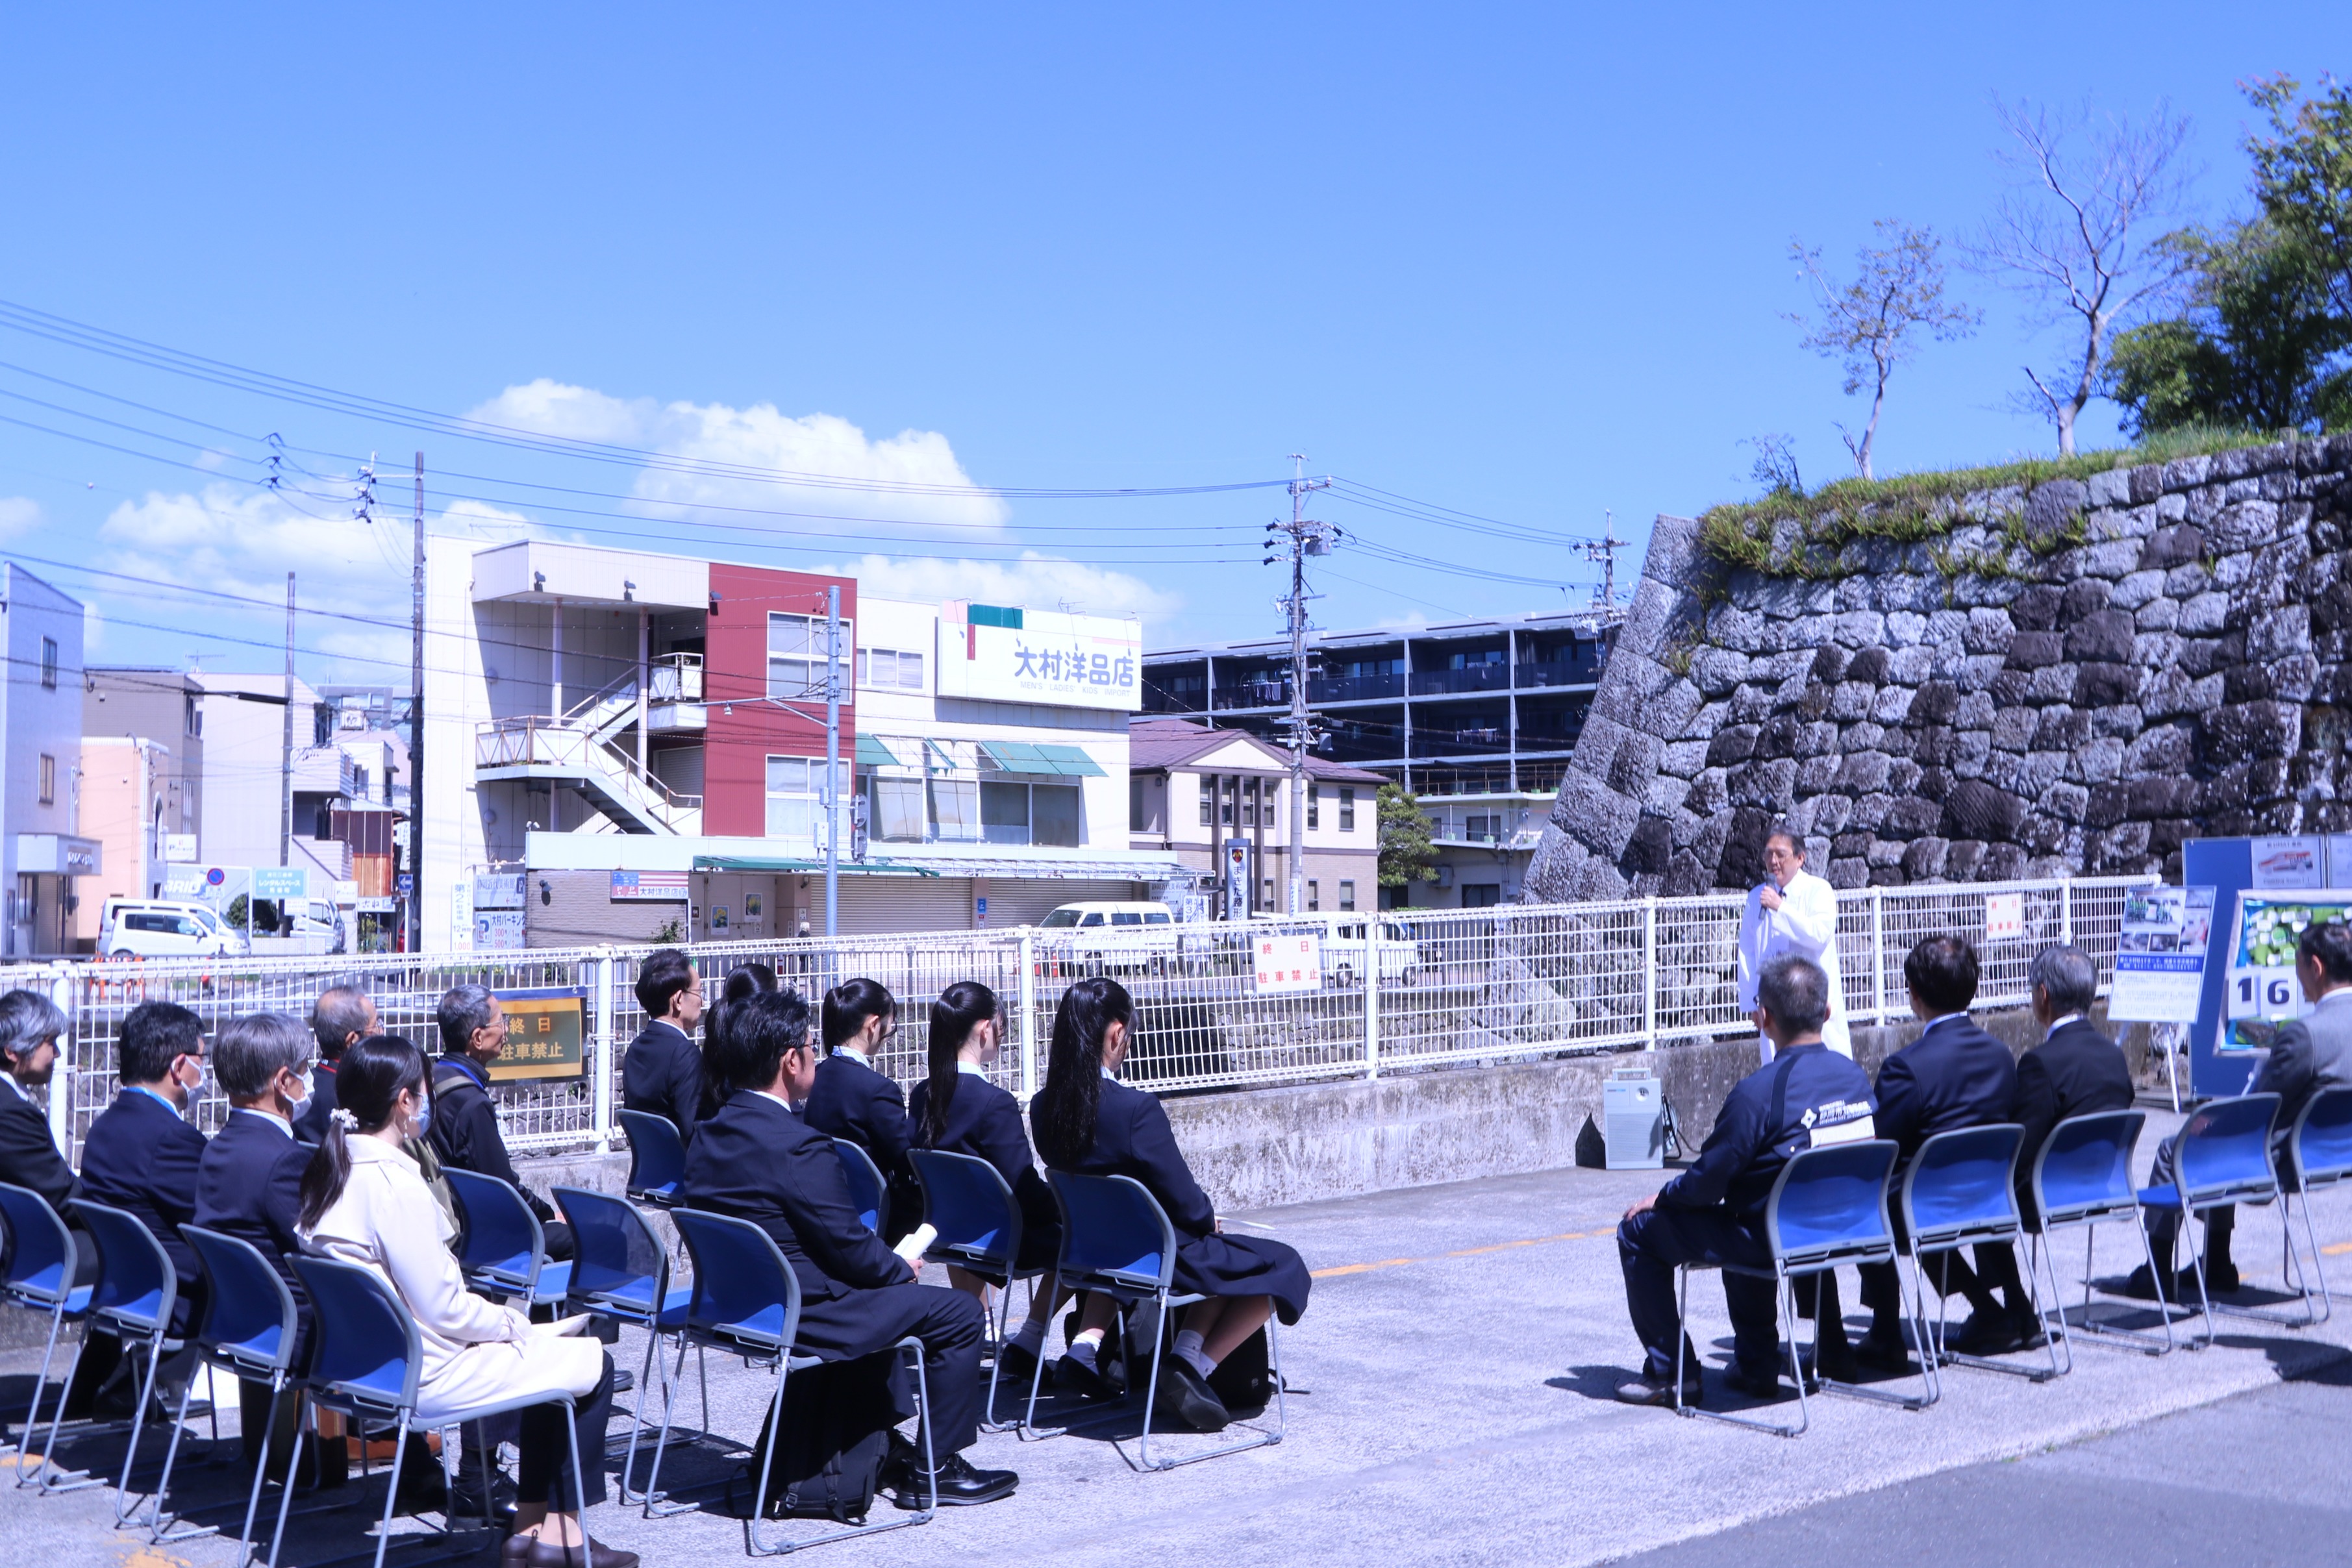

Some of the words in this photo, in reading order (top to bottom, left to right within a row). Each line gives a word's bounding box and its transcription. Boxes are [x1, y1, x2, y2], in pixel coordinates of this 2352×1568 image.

[1014, 645, 1134, 688] 大村洋品店
[1020, 680, 1043, 690] MEN'S
[1049, 683, 1076, 693] LADIES'
[1082, 686, 1098, 695] KIDS
[1105, 688, 1131, 697] IMPORT
[640, 887, 679, 897] 大村洋品店
[1232, 866, 1243, 940] まきた整形科
[1258, 968, 1319, 984] 駐車禁止
[497, 1041, 564, 1061] 駐車禁止
